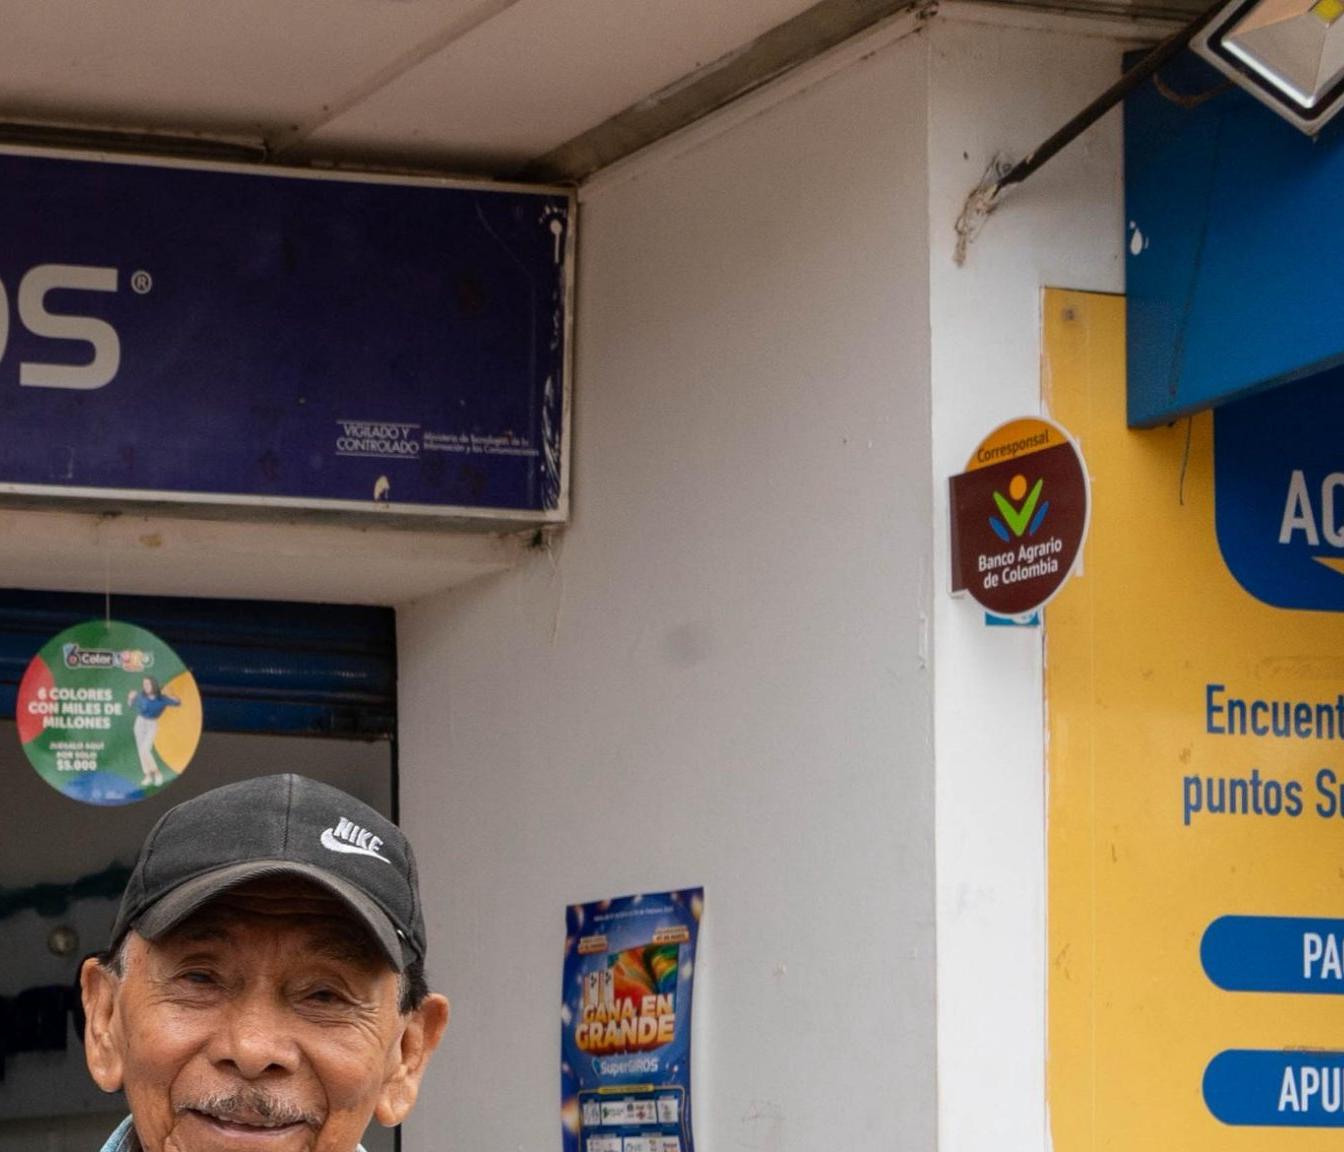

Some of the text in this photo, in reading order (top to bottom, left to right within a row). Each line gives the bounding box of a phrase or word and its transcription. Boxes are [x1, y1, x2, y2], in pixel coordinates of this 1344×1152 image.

[343, 423, 411, 440] VIGILADO Y
[336, 437, 419, 455] CONTROLADO
[976, 430, 1050, 463] Corresponsal
[978, 538, 1063, 573] Banco Agrario
[983, 558, 1059, 590] de Colombia
[37, 687, 113, 701] 6 COLORES
[28, 701, 123, 716] CON MILES DE
[42, 716, 111, 729] MILLONES
[1183, 768, 1303, 827] puntos
[334, 816, 384, 851] NIKE
[641, 992, 675, 1017] EN
[574, 1012, 675, 1052] GRANDE
